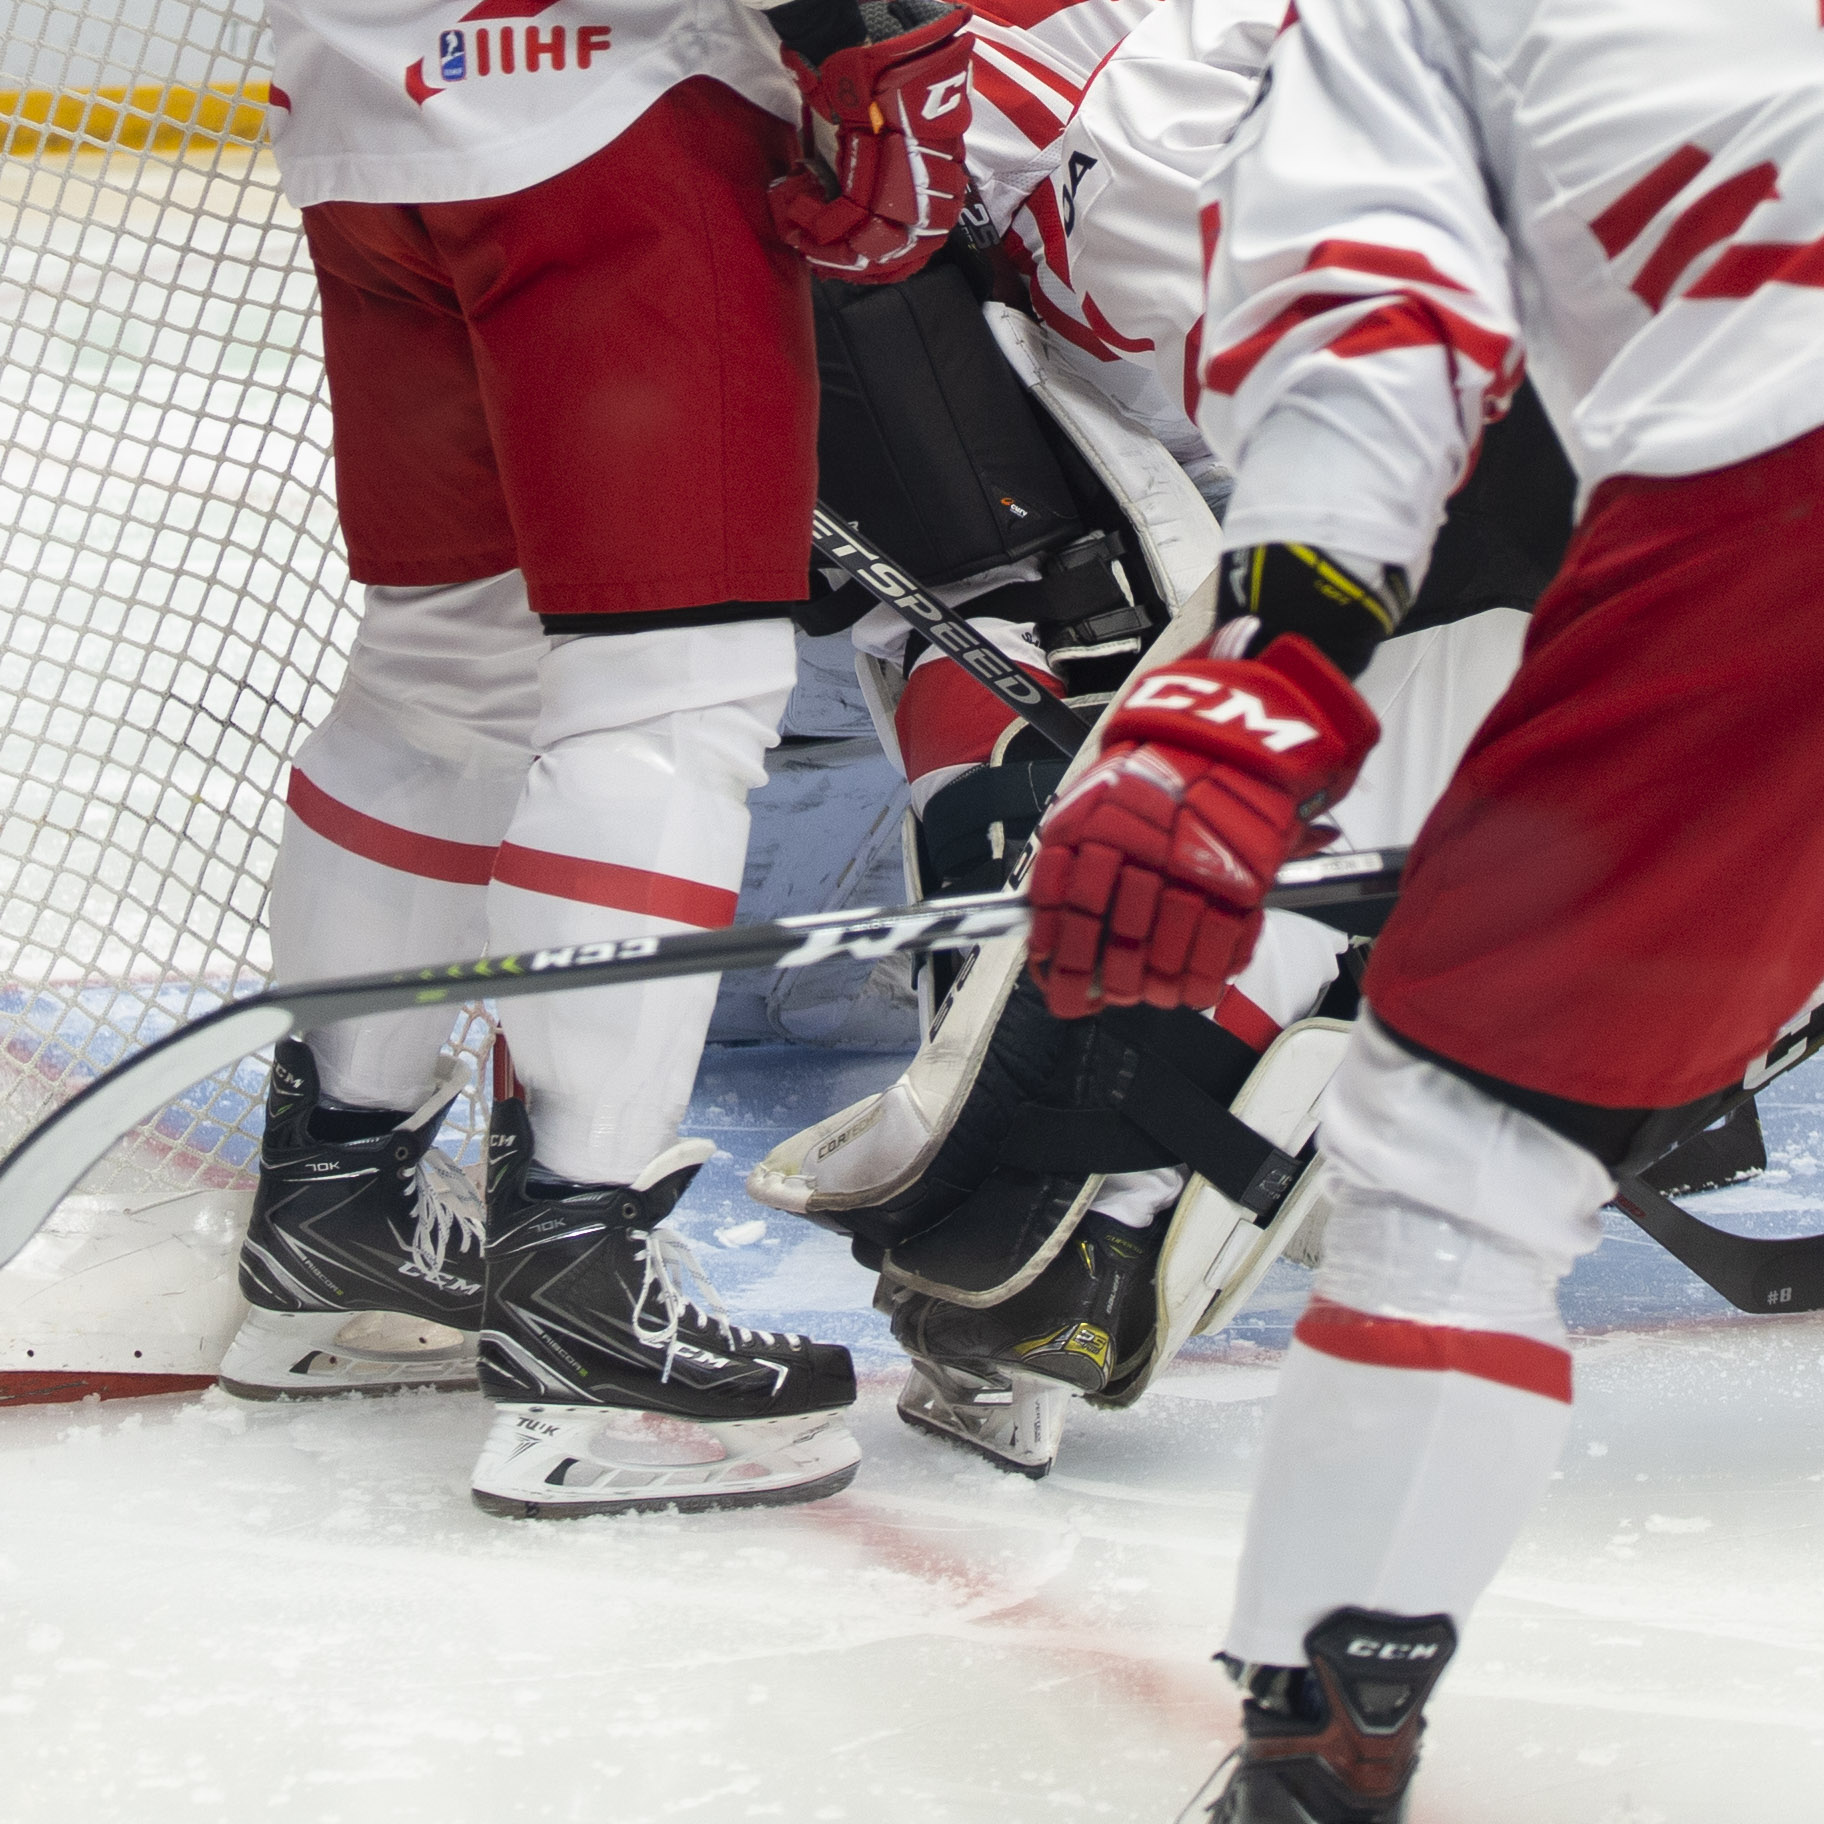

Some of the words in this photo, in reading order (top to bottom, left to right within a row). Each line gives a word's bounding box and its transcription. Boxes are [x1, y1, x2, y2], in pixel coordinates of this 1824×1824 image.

[476, 24, 612, 78] IIHF
[813, 512, 1044, 708] ETSPEED
[1123, 675, 1320, 754] CM
[530, 937, 660, 974] CCM
[304, 1160, 341, 1173] 70K
[528, 1216, 567, 1233] 70K
[397, 1261, 484, 1297] CCM
[1766, 1286, 1793, 1307] #8
[1345, 1635, 1439, 1661] CCM
